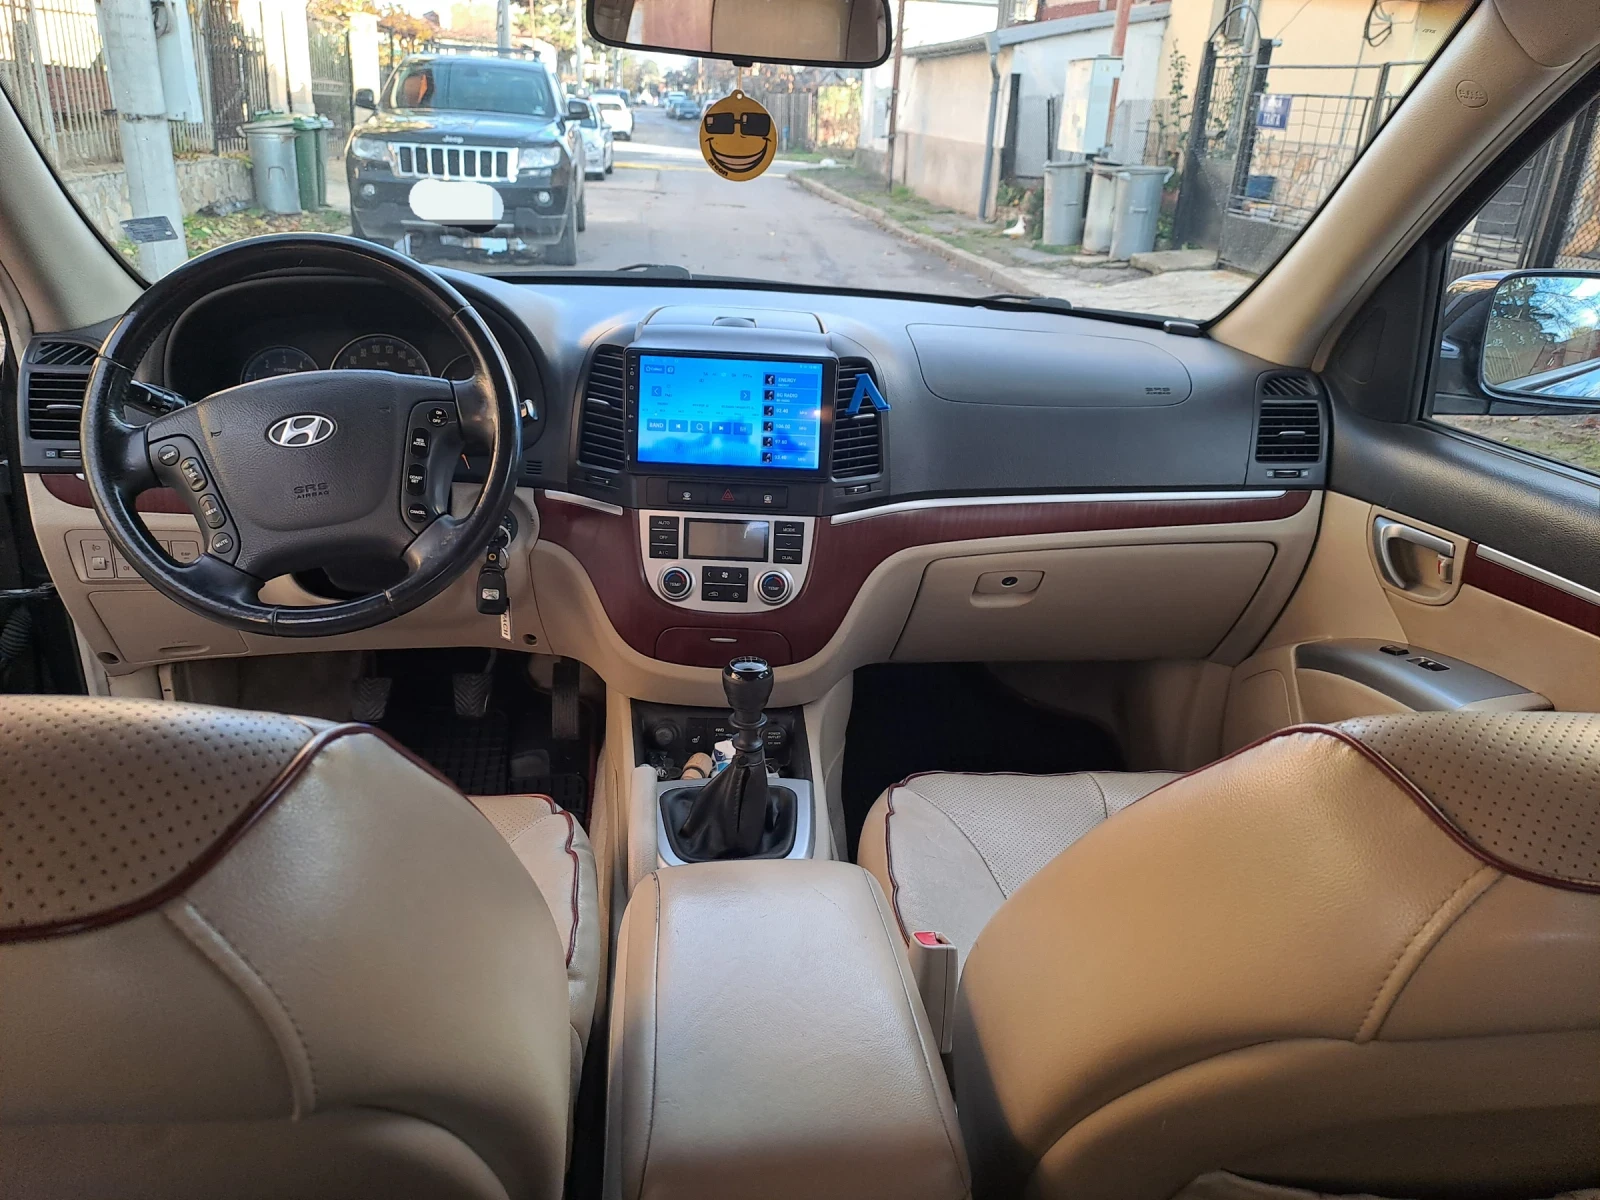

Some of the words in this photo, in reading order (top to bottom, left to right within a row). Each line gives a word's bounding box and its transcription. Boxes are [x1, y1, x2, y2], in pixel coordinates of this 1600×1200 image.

[441, 135, 464, 144] Jeep
[708, 158, 728, 177] areon
[162, 451, 176, 460] MODE
[293, 482, 329, 494] SRS
[297, 490, 329, 499] AIRBAG
[205, 507, 218, 516] SEEK
[215, 538, 229, 548] MUTE
